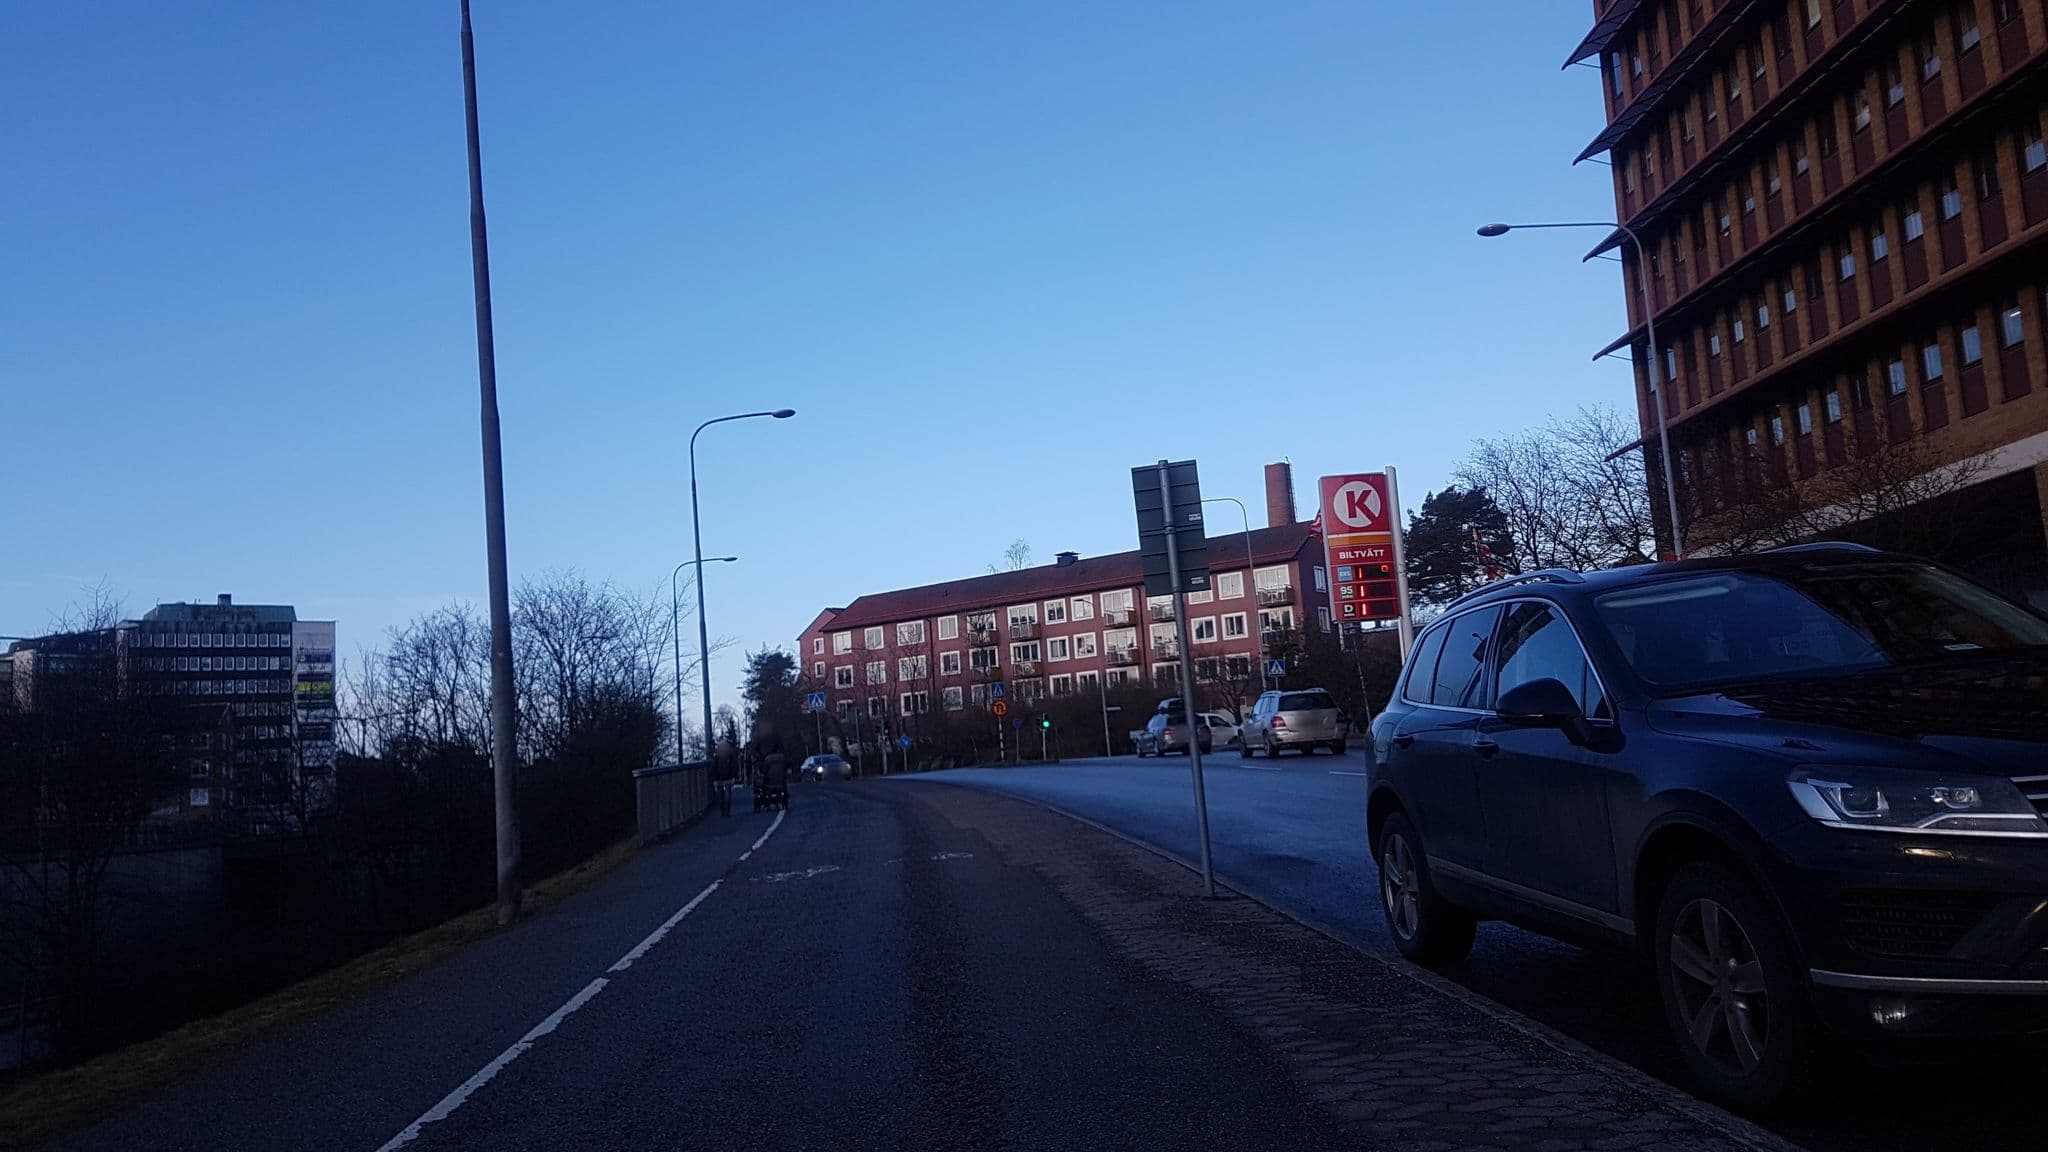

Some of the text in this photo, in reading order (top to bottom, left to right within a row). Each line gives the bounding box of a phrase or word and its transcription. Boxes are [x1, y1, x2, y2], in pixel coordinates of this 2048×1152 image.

[1345, 489, 1378, 524] K
[1339, 548, 1385, 559] BILTVÄTT
[1340, 585, 1353, 595] 95
[1344, 604, 1353, 613] D
